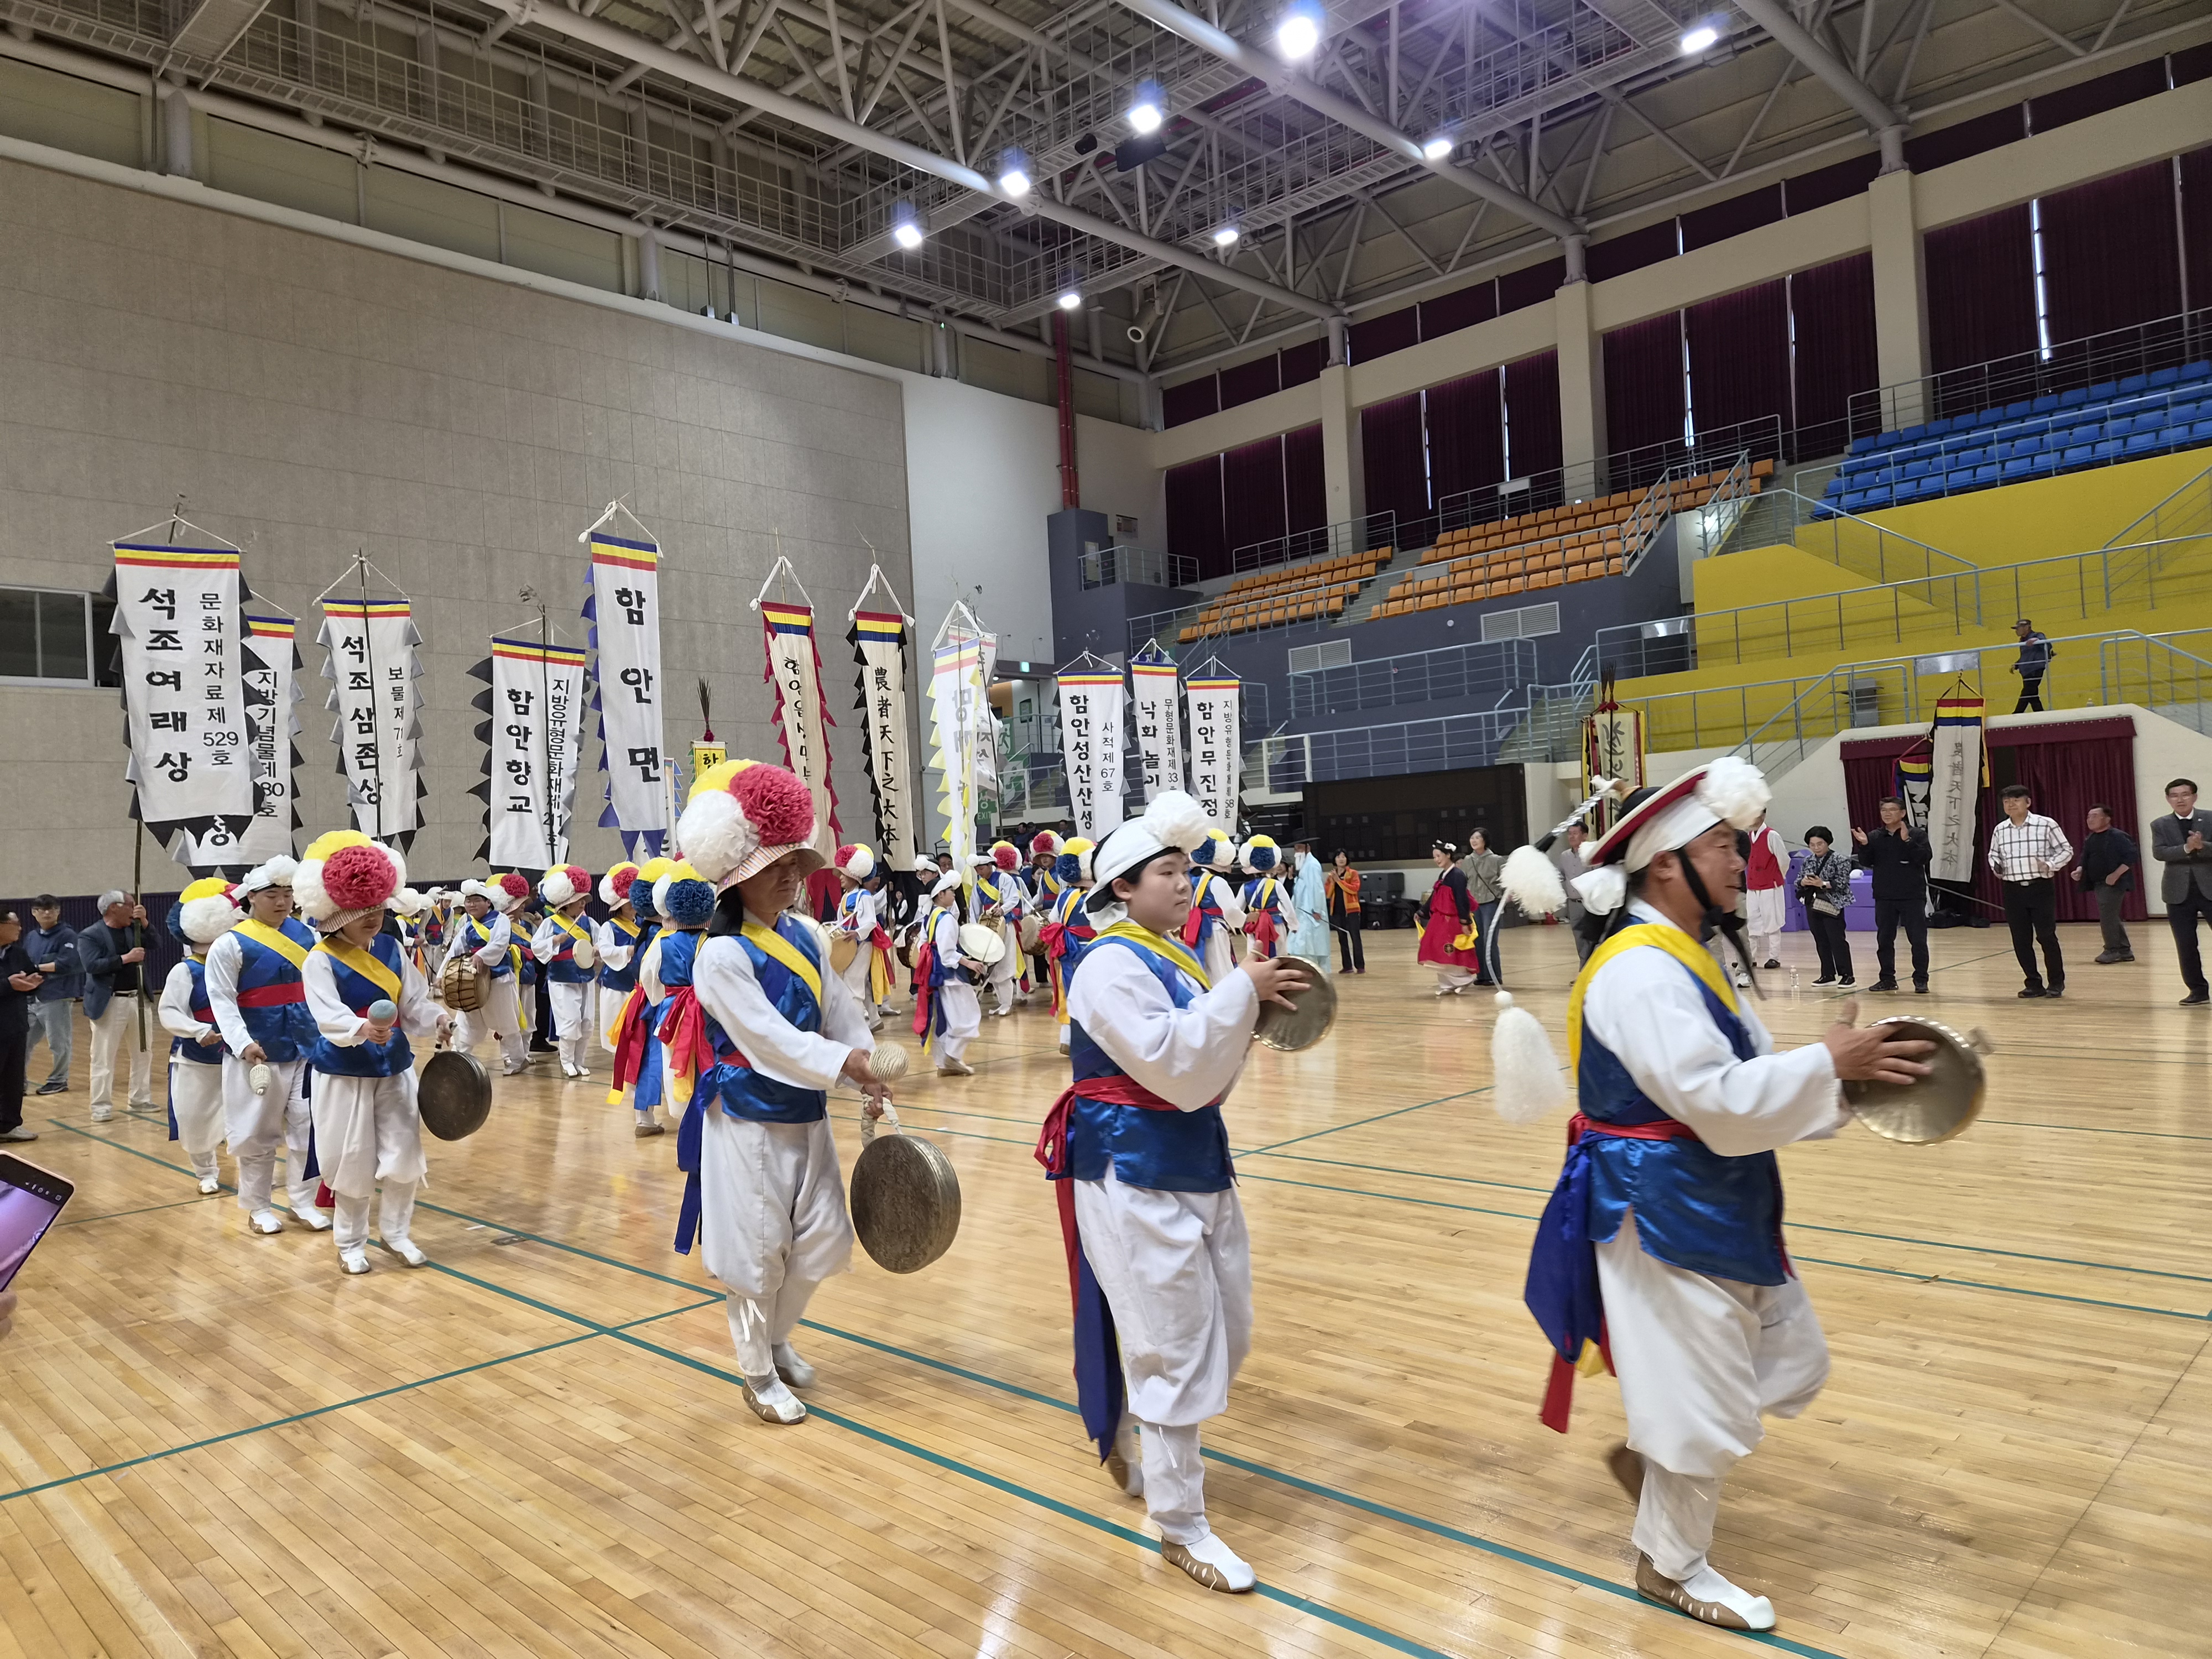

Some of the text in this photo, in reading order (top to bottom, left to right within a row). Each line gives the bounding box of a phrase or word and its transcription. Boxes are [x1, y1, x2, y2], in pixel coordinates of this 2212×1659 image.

[138, 587, 191, 782] 석조여래상
[341, 635, 383, 805] 석조삼존상
[506, 688, 535, 813] 함안향교
[614, 587, 661, 783] 함안면
[874, 666, 900, 846] 農者天下之大本
[977, 811, 992, 820] EXIT
[1069, 695, 1093, 830] 함안성산산성
[1140, 701, 1160, 806] 낙화놀이
[1197, 701, 1218, 817] 함안무진정
